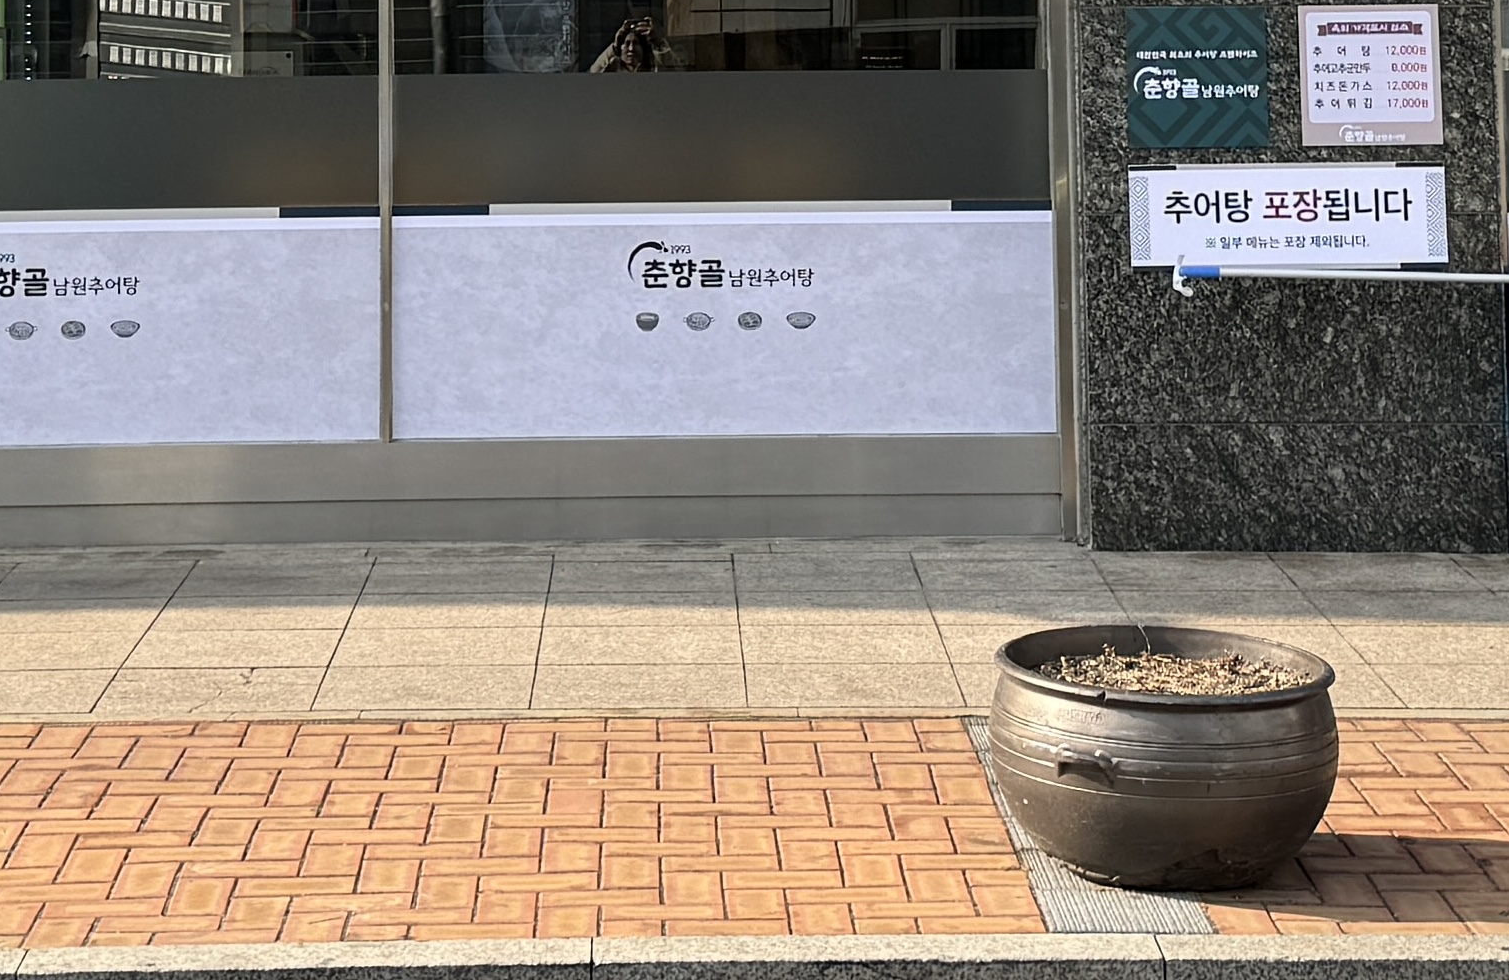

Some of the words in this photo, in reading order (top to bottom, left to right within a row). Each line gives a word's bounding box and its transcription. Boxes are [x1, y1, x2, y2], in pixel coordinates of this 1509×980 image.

[1143, 77, 1200, 99] 춘향골
[1201, 84, 1260, 98] 남원추어탕
[1164, 189, 1253, 224] 추어탕
[1263, 188, 1413, 223] 포장됩니다
[670, 244, 691, 254] 1993
[1219, 236, 1242, 249] 일부
[1246, 236, 1280, 249] 메뉴는
[1284, 236, 1306, 248] 포장
[642, 259, 725, 288] 춘향골
[729, 268, 815, 288] 남원추어탕
[53, 276, 140, 297] 남원추어탕
